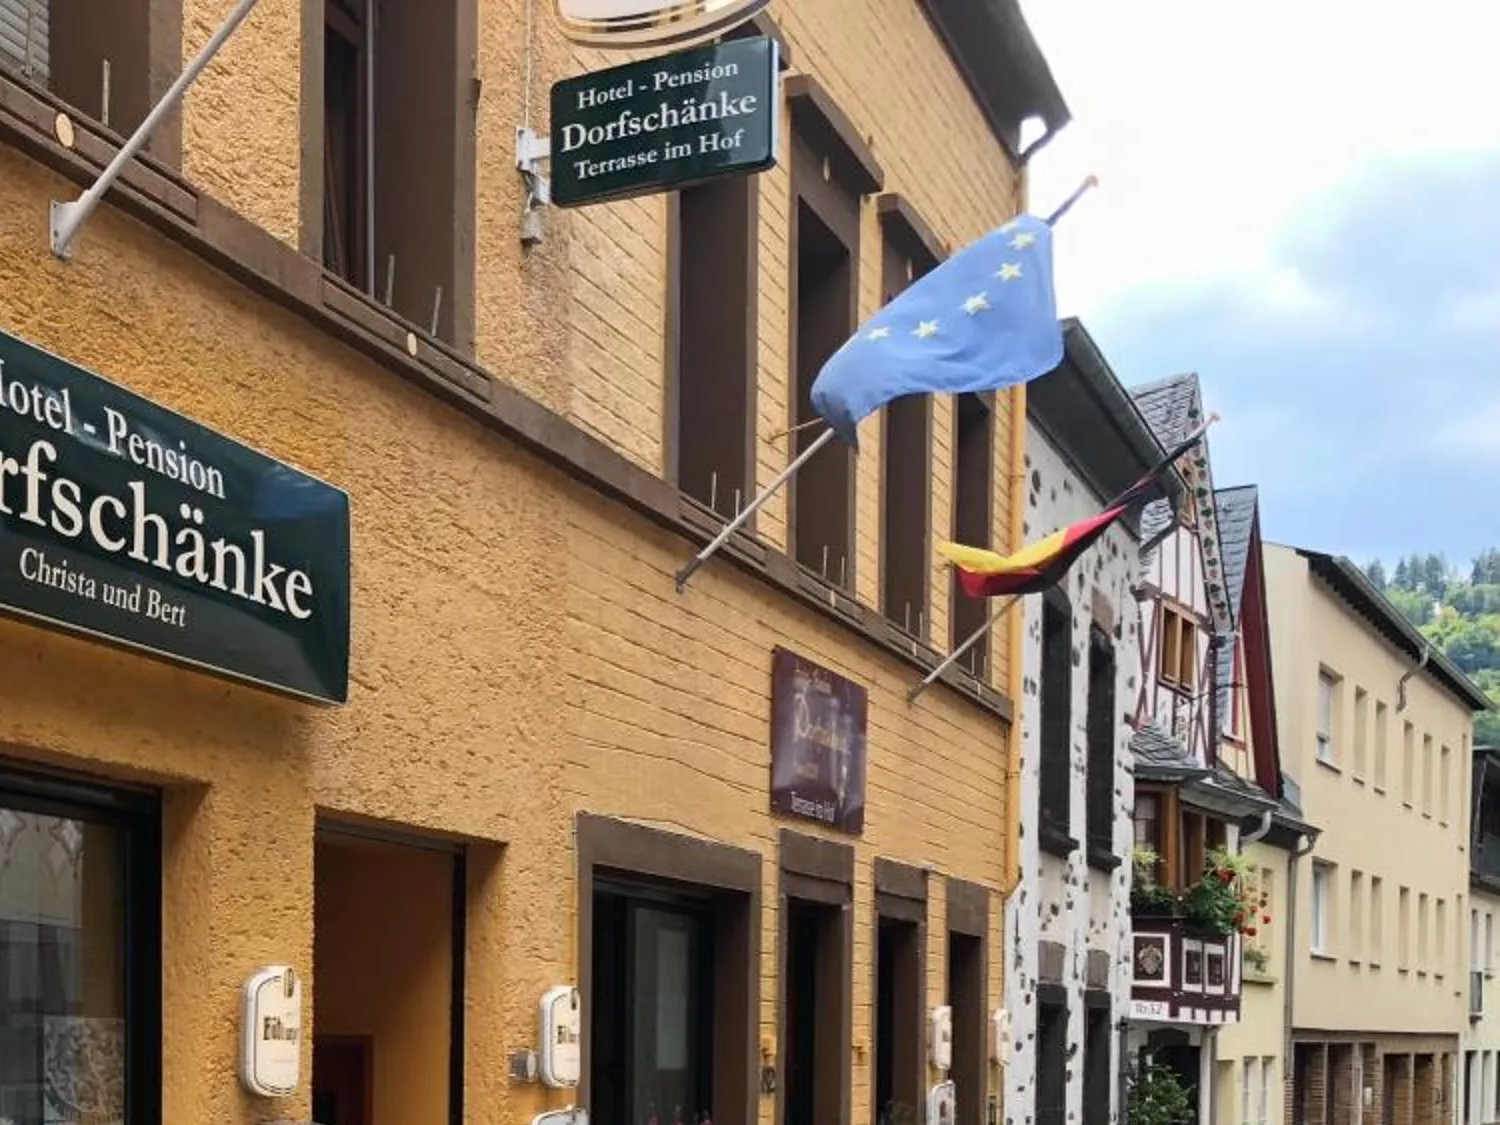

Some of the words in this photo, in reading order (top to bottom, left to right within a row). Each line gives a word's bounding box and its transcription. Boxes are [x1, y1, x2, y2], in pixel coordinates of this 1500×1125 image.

[577, 79, 633, 109] Hotel
[653, 61, 739, 91] Pension
[561, 89, 758, 153] Dorfschänke
[574, 149, 658, 179] Terrasse
[664, 141, 692, 160] im
[699, 127, 745, 153] Hof
[103, 406, 226, 499] Pension
[19, 547, 97, 600] Christa
[102, 583, 141, 614] und
[146, 588, 187, 628] Bert
